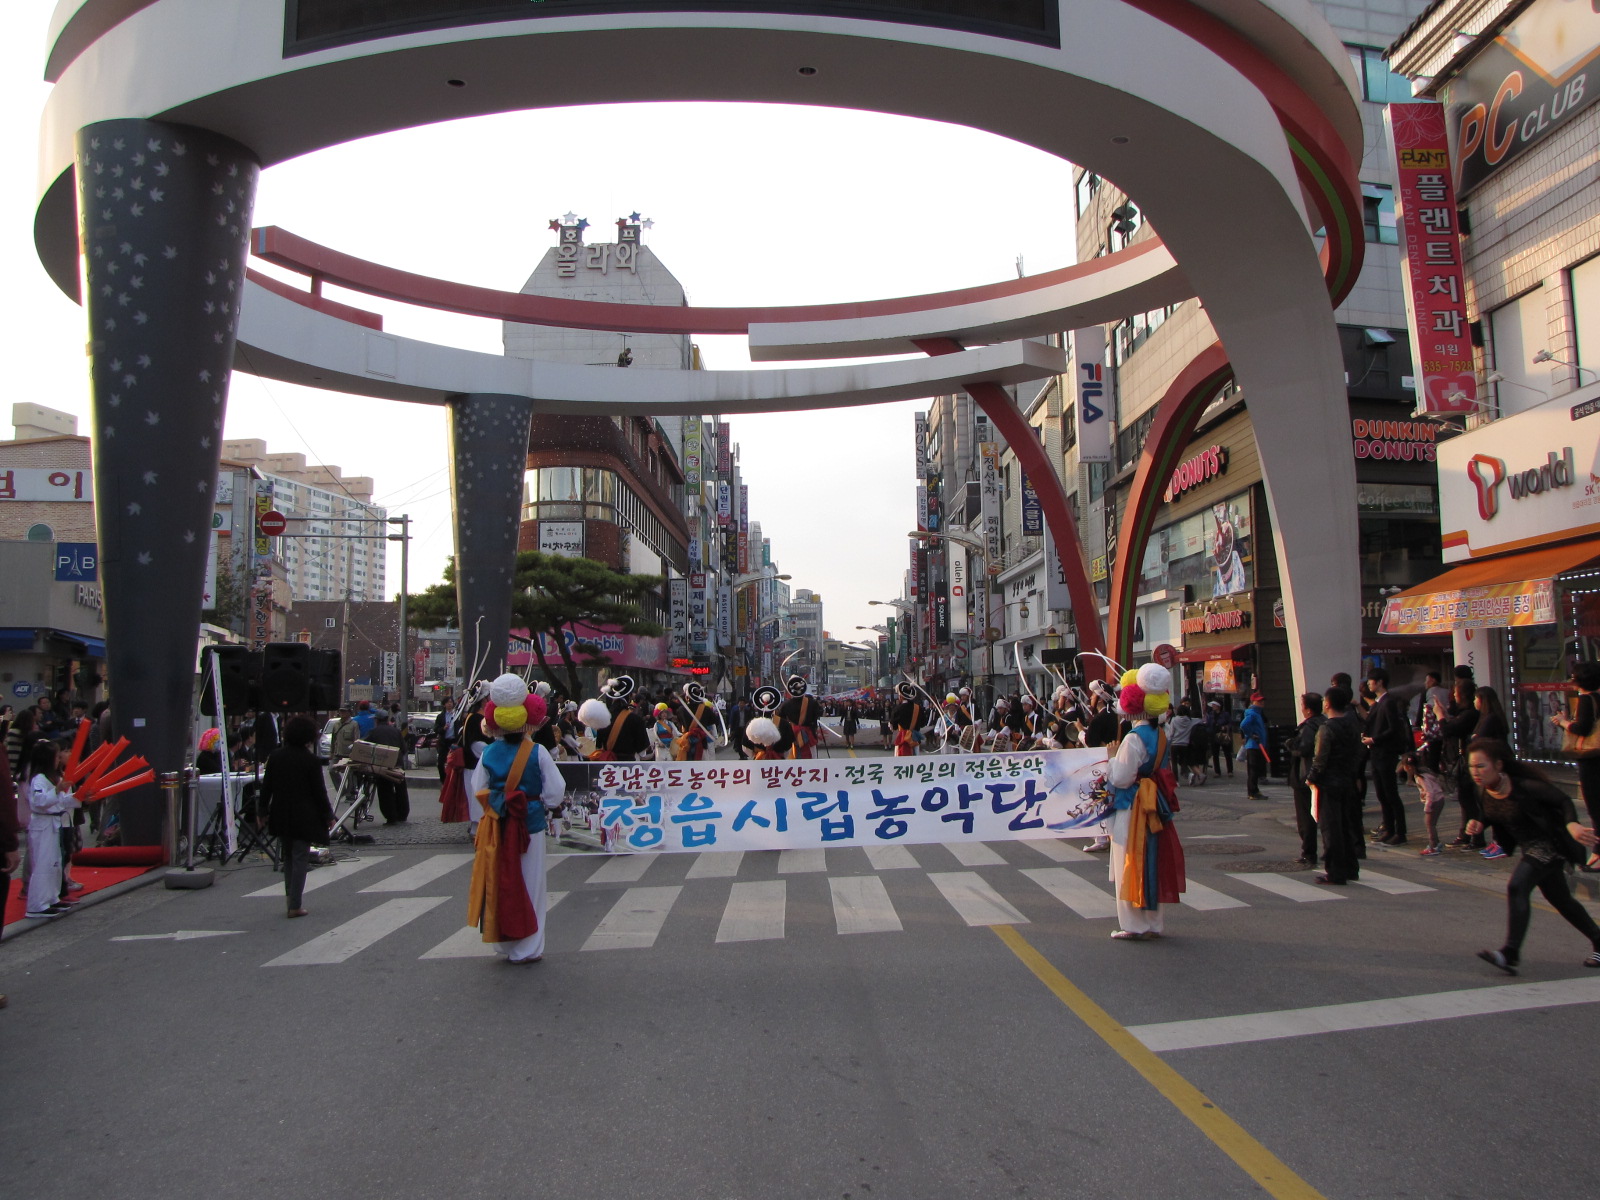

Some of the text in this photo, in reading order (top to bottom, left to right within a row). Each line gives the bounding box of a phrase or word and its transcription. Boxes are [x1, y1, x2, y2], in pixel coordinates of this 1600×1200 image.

[1454, 70, 1586, 193] PC CLUB
[1401, 149, 1446, 164] PLANT
[1402, 188, 1429, 336] PLANT DENTAL CLINIC
[1415, 173, 1464, 338] 플랜트치과
[1423, 360, 1474, 373] 535-7528
[1434, 343, 1459, 356] 의원
[1080, 362, 1104, 424] FILA
[915, 423, 924, 467] BOSS
[1353, 419, 1441, 442] DUNKIN'
[1354, 440, 1437, 462] DONUTS
[984, 457, 997, 496] 정선자
[1507, 446, 1575, 500] world
[988, 516, 999, 558] 헤어라인
[692, 576, 704, 587] 책
[954, 560, 962, 583] olleh
[1432, 604, 1445, 621] 고객
[1448, 601, 1468, 619] 무조건
[1513, 594, 1530, 615] 증정
[15, 685, 29, 693] ADT
[601, 766, 751, 791] 호남우도농악의
[893, 761, 956, 783] 제일의
[965, 757, 1044, 780] 정읍농악
[601, 779, 1048, 848] 정읍시립농악단
